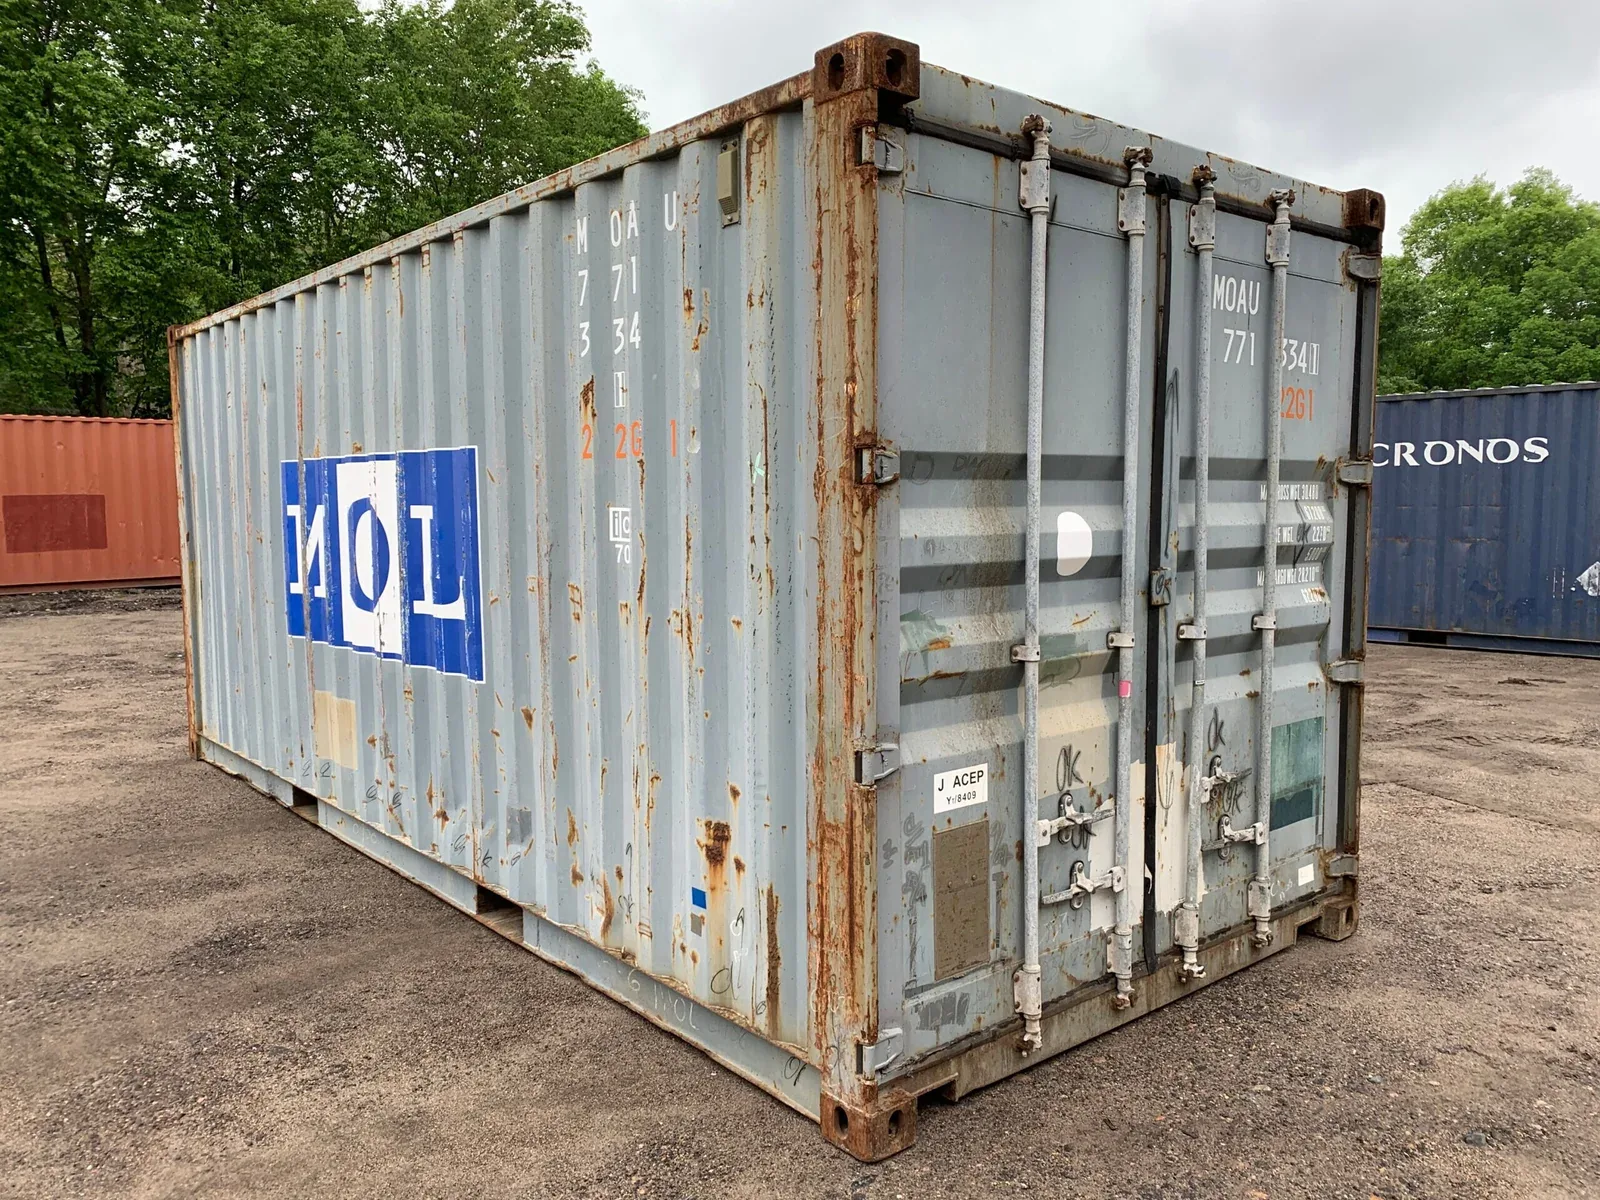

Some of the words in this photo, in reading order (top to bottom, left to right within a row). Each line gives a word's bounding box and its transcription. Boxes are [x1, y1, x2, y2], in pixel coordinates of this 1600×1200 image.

[1213, 274, 1261, 316] MOAU
[1223, 328, 1256, 366] 771
[1373, 436, 1549, 467] CRONOS
[614, 544, 631, 564] 70
[937, 778, 945, 792] J
[952, 769, 985, 789] ACEP
[1056, 744, 1084, 792] OK
